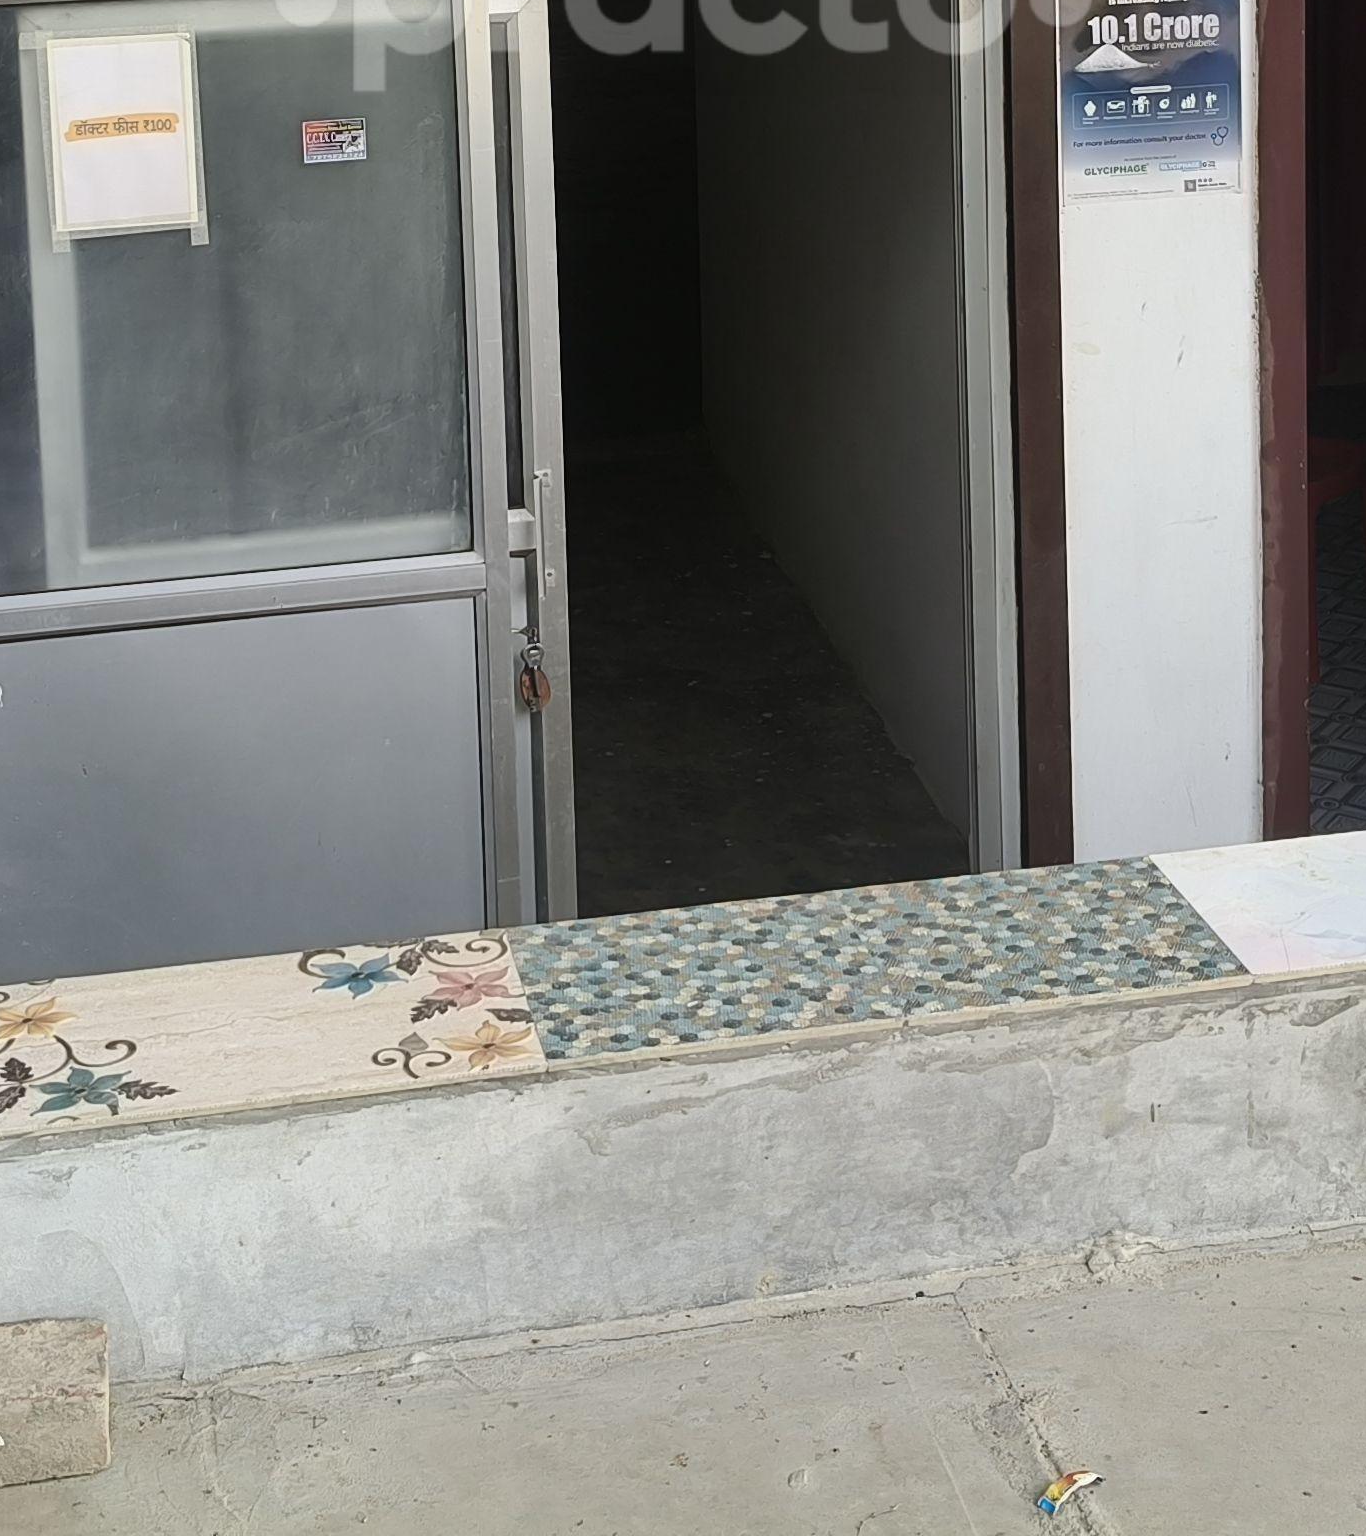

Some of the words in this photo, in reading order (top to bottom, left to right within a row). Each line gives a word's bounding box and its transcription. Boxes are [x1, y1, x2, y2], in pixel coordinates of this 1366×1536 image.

[1088, 14, 1138, 45] 10.1
[1143, 13, 1220, 42] Crore
[1122, 43, 1151, 52] Indians
[1152, 43, 1166, 51] are
[1167, 41, 1185, 50] now
[74, 119, 110, 137] डॉक्टर
[113, 117, 140, 135] फीस
[143, 119, 172, 133] ₹100
[1084, 164, 1147, 176] GLYCIPHAGE
